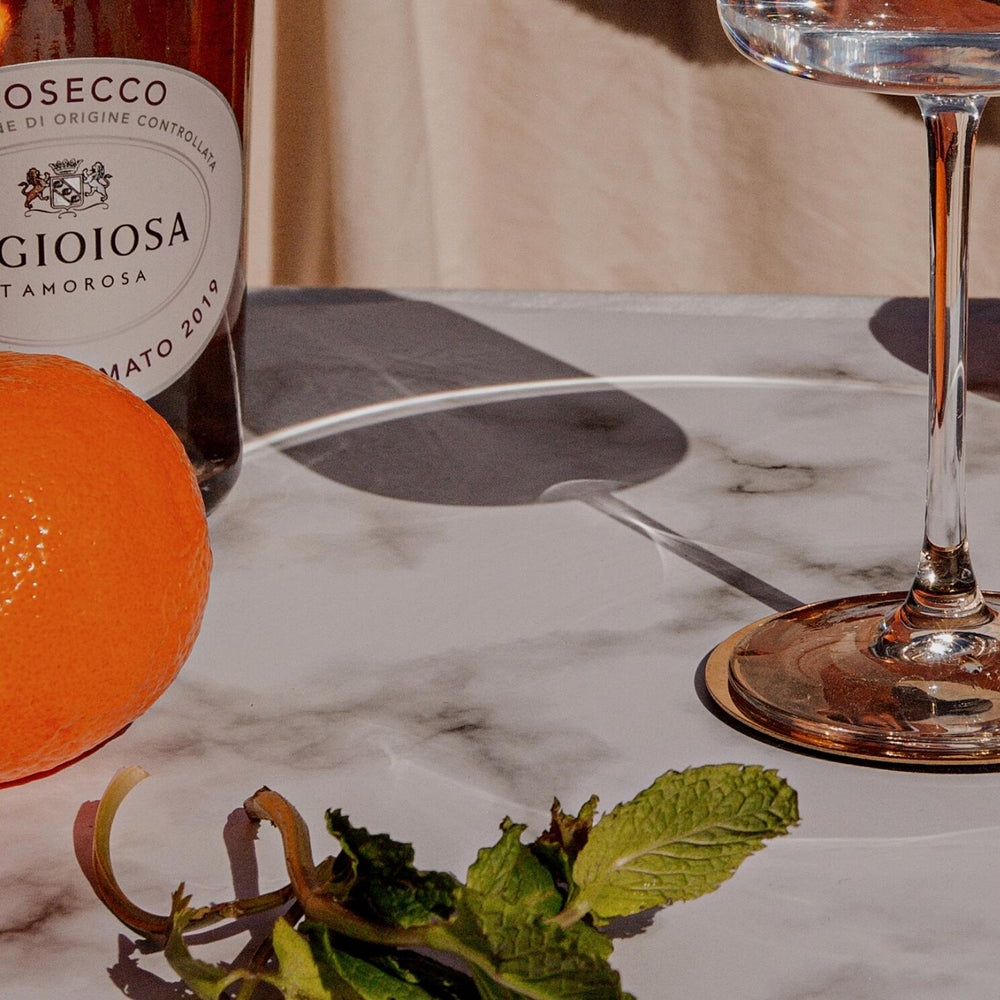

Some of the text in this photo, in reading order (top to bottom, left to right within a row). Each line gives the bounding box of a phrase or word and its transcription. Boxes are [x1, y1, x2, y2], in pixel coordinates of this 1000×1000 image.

[4, 76, 168, 110] OSECCO
[25, 115, 44, 129] DI
[54, 110, 130, 125] ORIGINE
[137, 114, 218, 174] CONTROLLATA
[0, 211, 190, 269] GIOIOSA
[22, 269, 147, 297] AMOROSA
[181, 278, 220, 339] 2019
